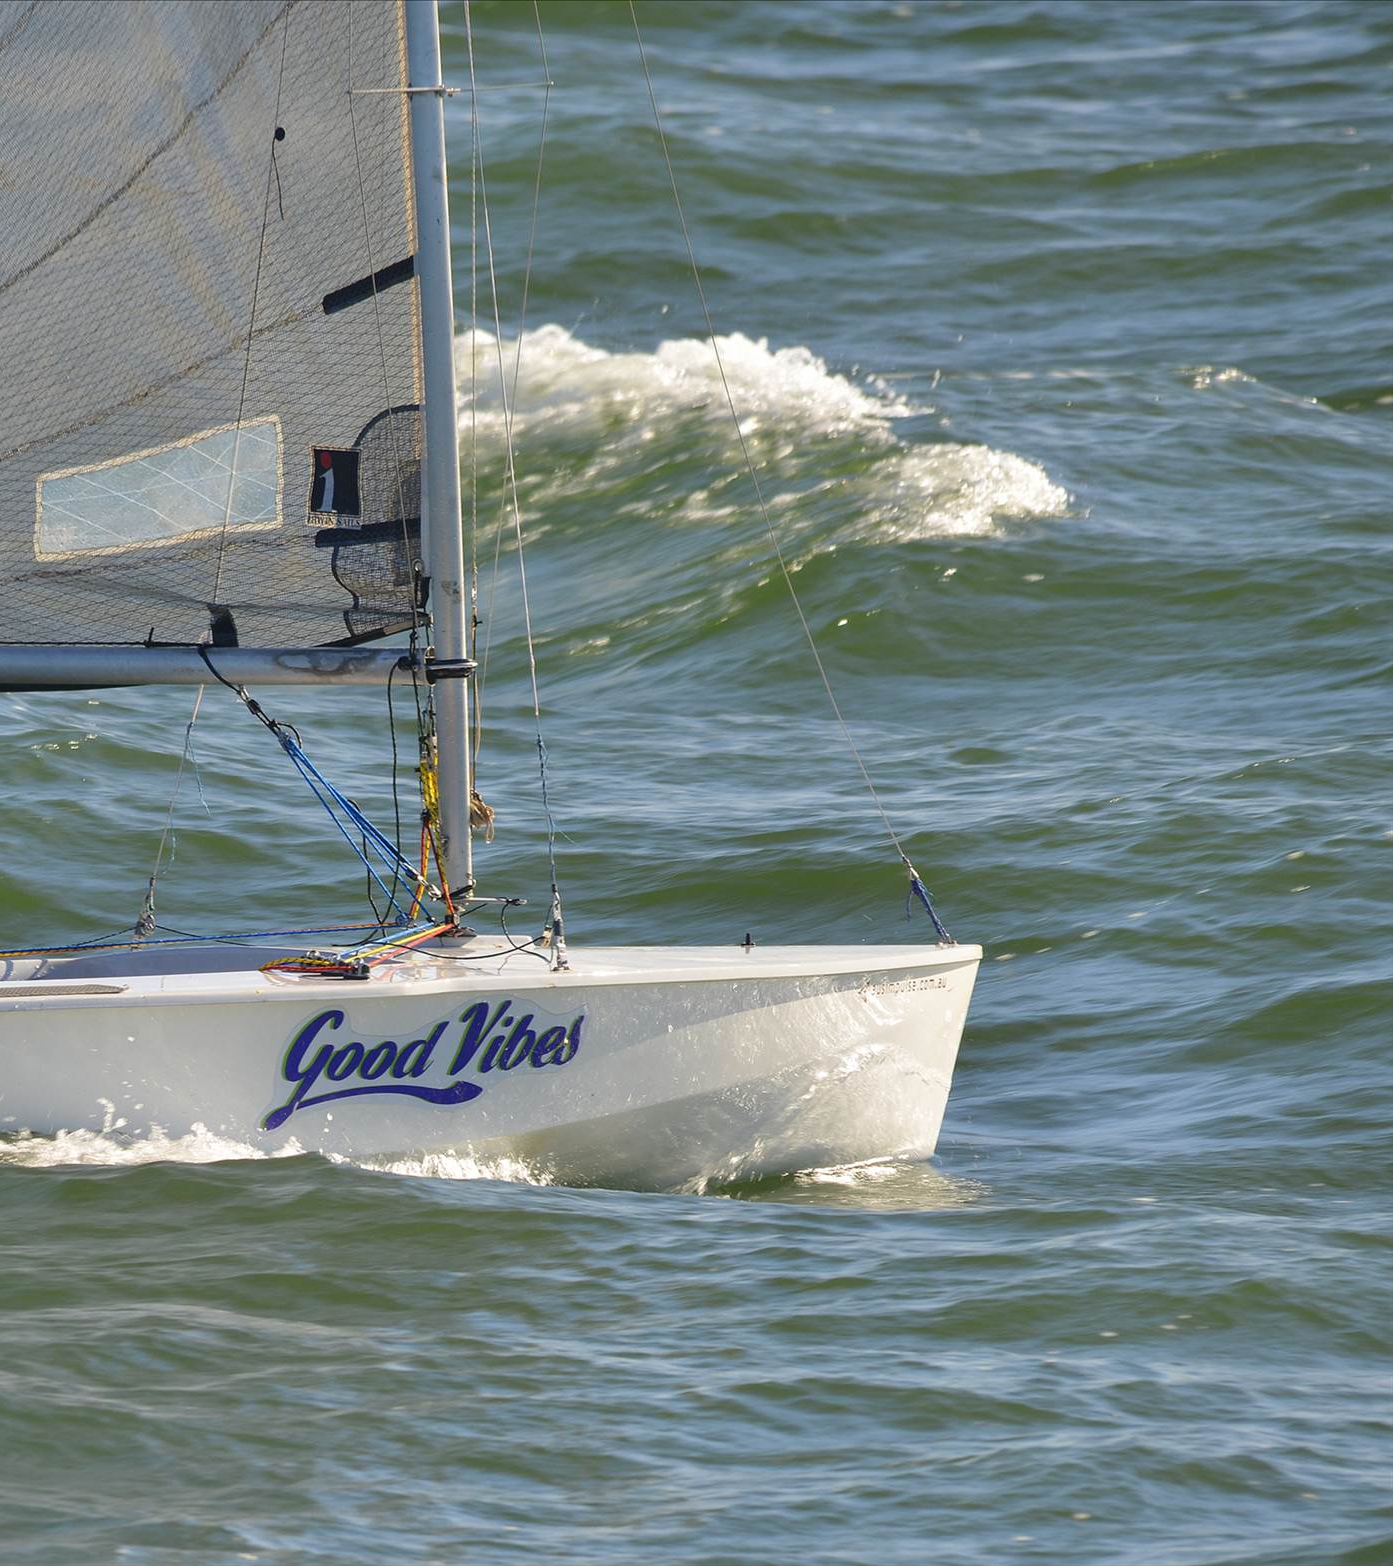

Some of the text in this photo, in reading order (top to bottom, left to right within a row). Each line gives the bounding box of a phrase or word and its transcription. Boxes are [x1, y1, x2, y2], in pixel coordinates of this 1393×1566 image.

[337, 516, 362, 528] SAILS
[262, 999, 585, 1126] Good Vibes
